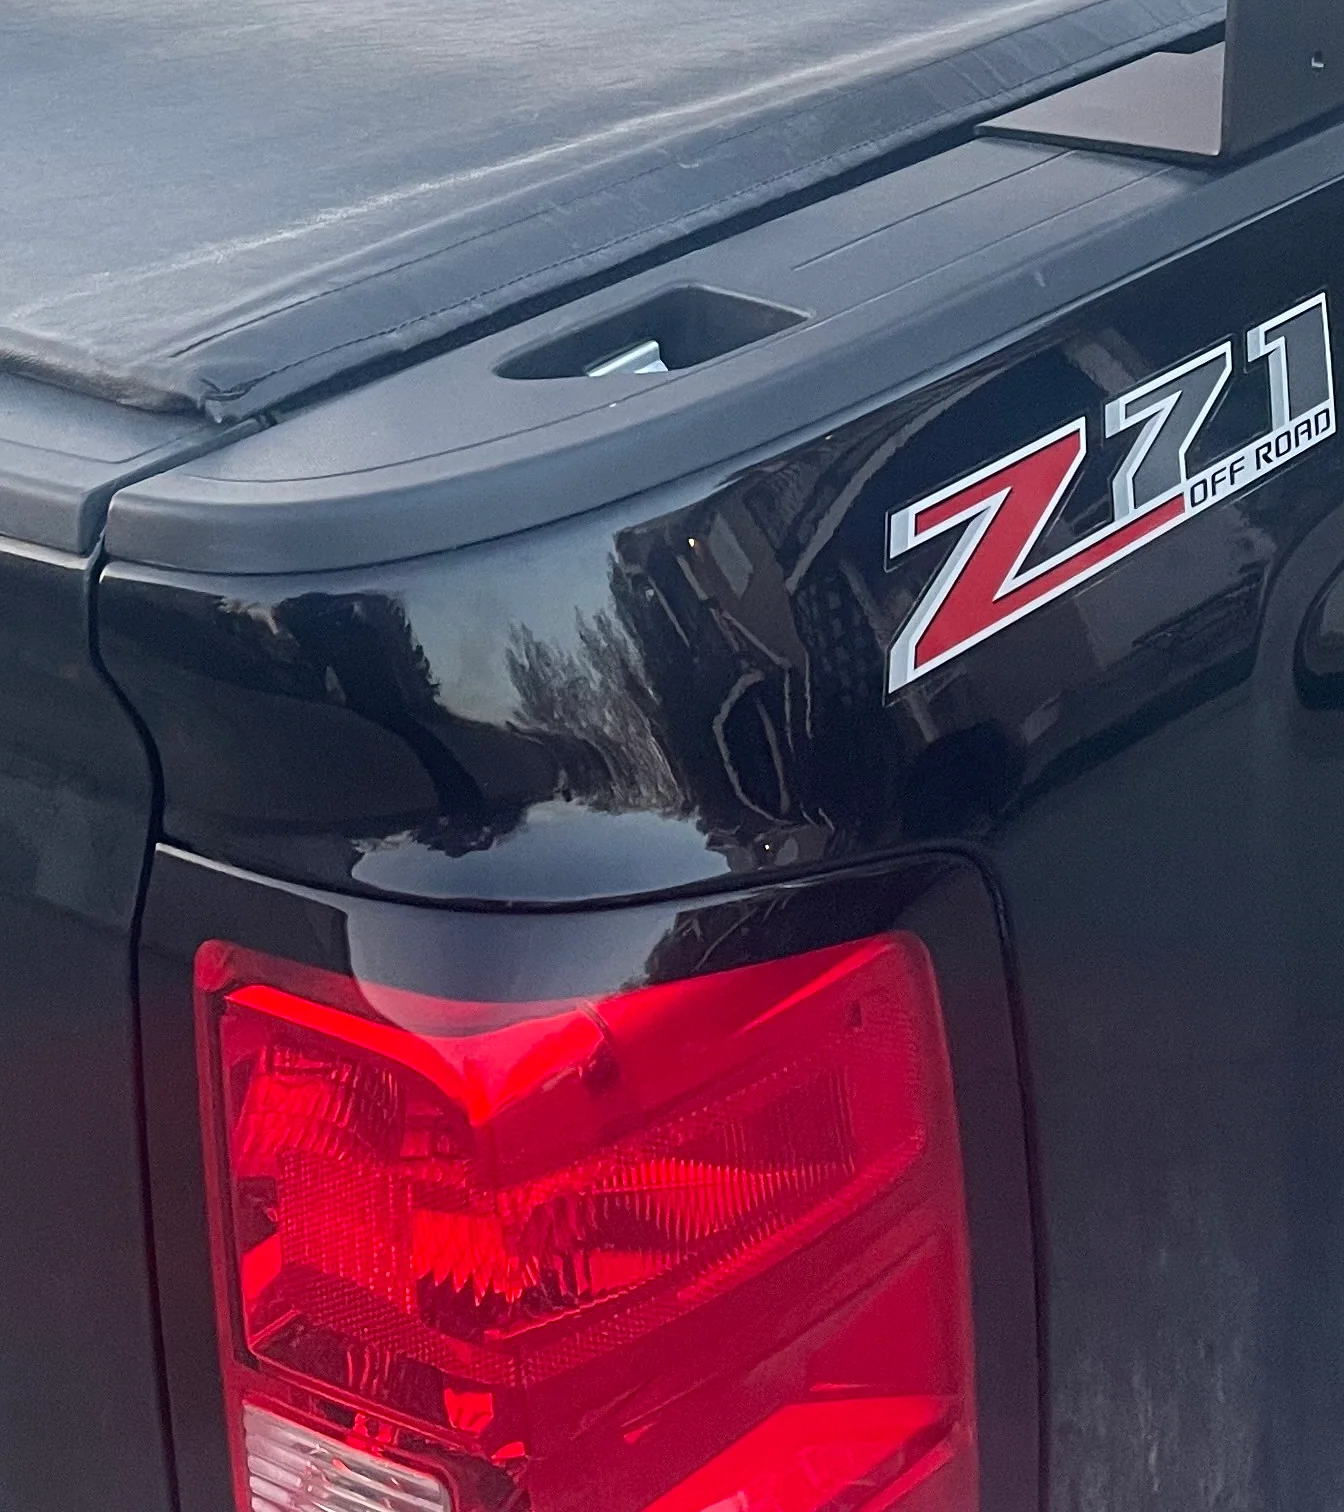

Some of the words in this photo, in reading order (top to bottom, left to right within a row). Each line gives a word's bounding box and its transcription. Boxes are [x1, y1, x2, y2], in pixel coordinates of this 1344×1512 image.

[887, 292, 1336, 694] Z71
[1190, 455, 1246, 508] OFF
[1255, 407, 1331, 470] ROAD
